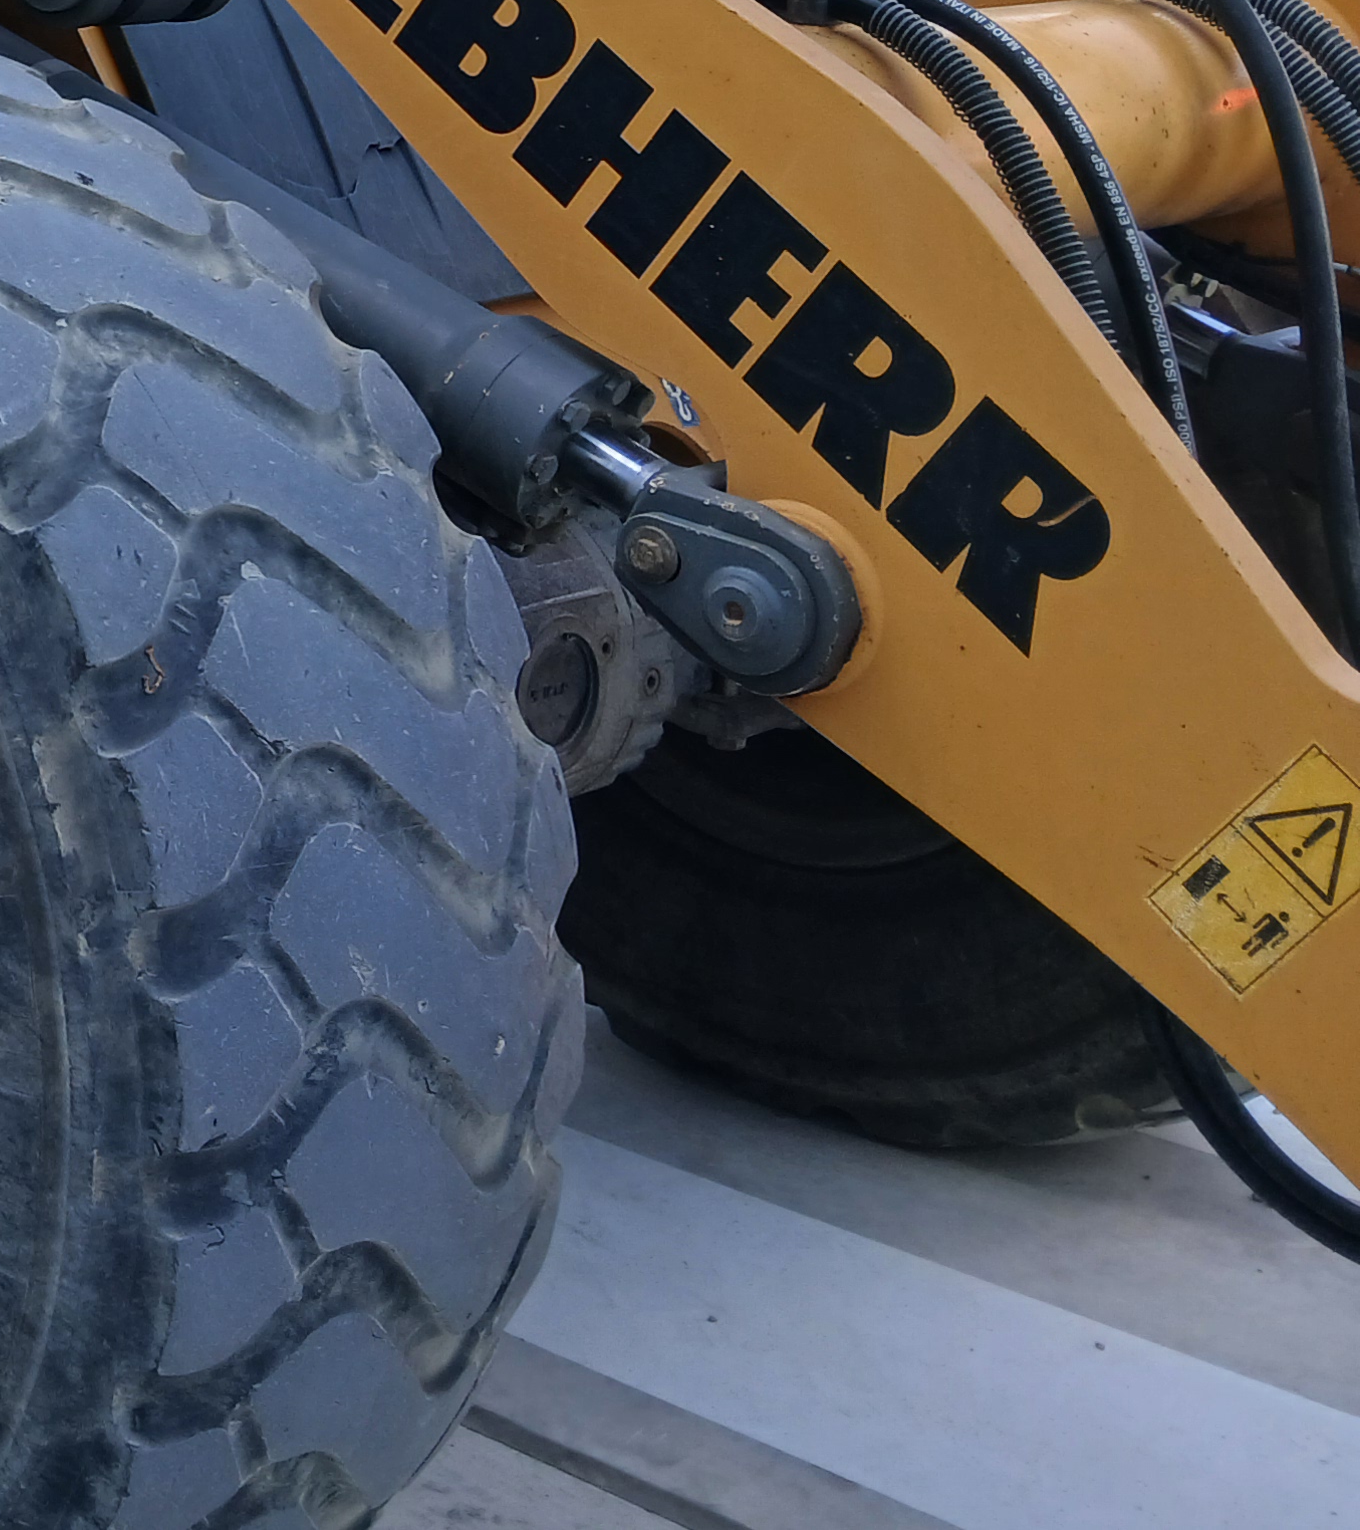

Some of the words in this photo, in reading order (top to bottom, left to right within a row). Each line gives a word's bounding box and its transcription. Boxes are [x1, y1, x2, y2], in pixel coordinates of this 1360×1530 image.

[970, 10, 987, 25] IN
[984, 21, 1022, 52] MADE
[1023, 56, 1068, 106] IC-152/16
[1064, 107, 1093, 146] MSHA
[1091, 154, 1110, 179] 4SP
[1104, 180, 1122, 205] 856
[1114, 206, 1131, 227] EN
[1125, 228, 1151, 282] exceeds
[1145, 292, 1173, 355] 18752/CC
[1162, 358, 1178, 383] ISO
